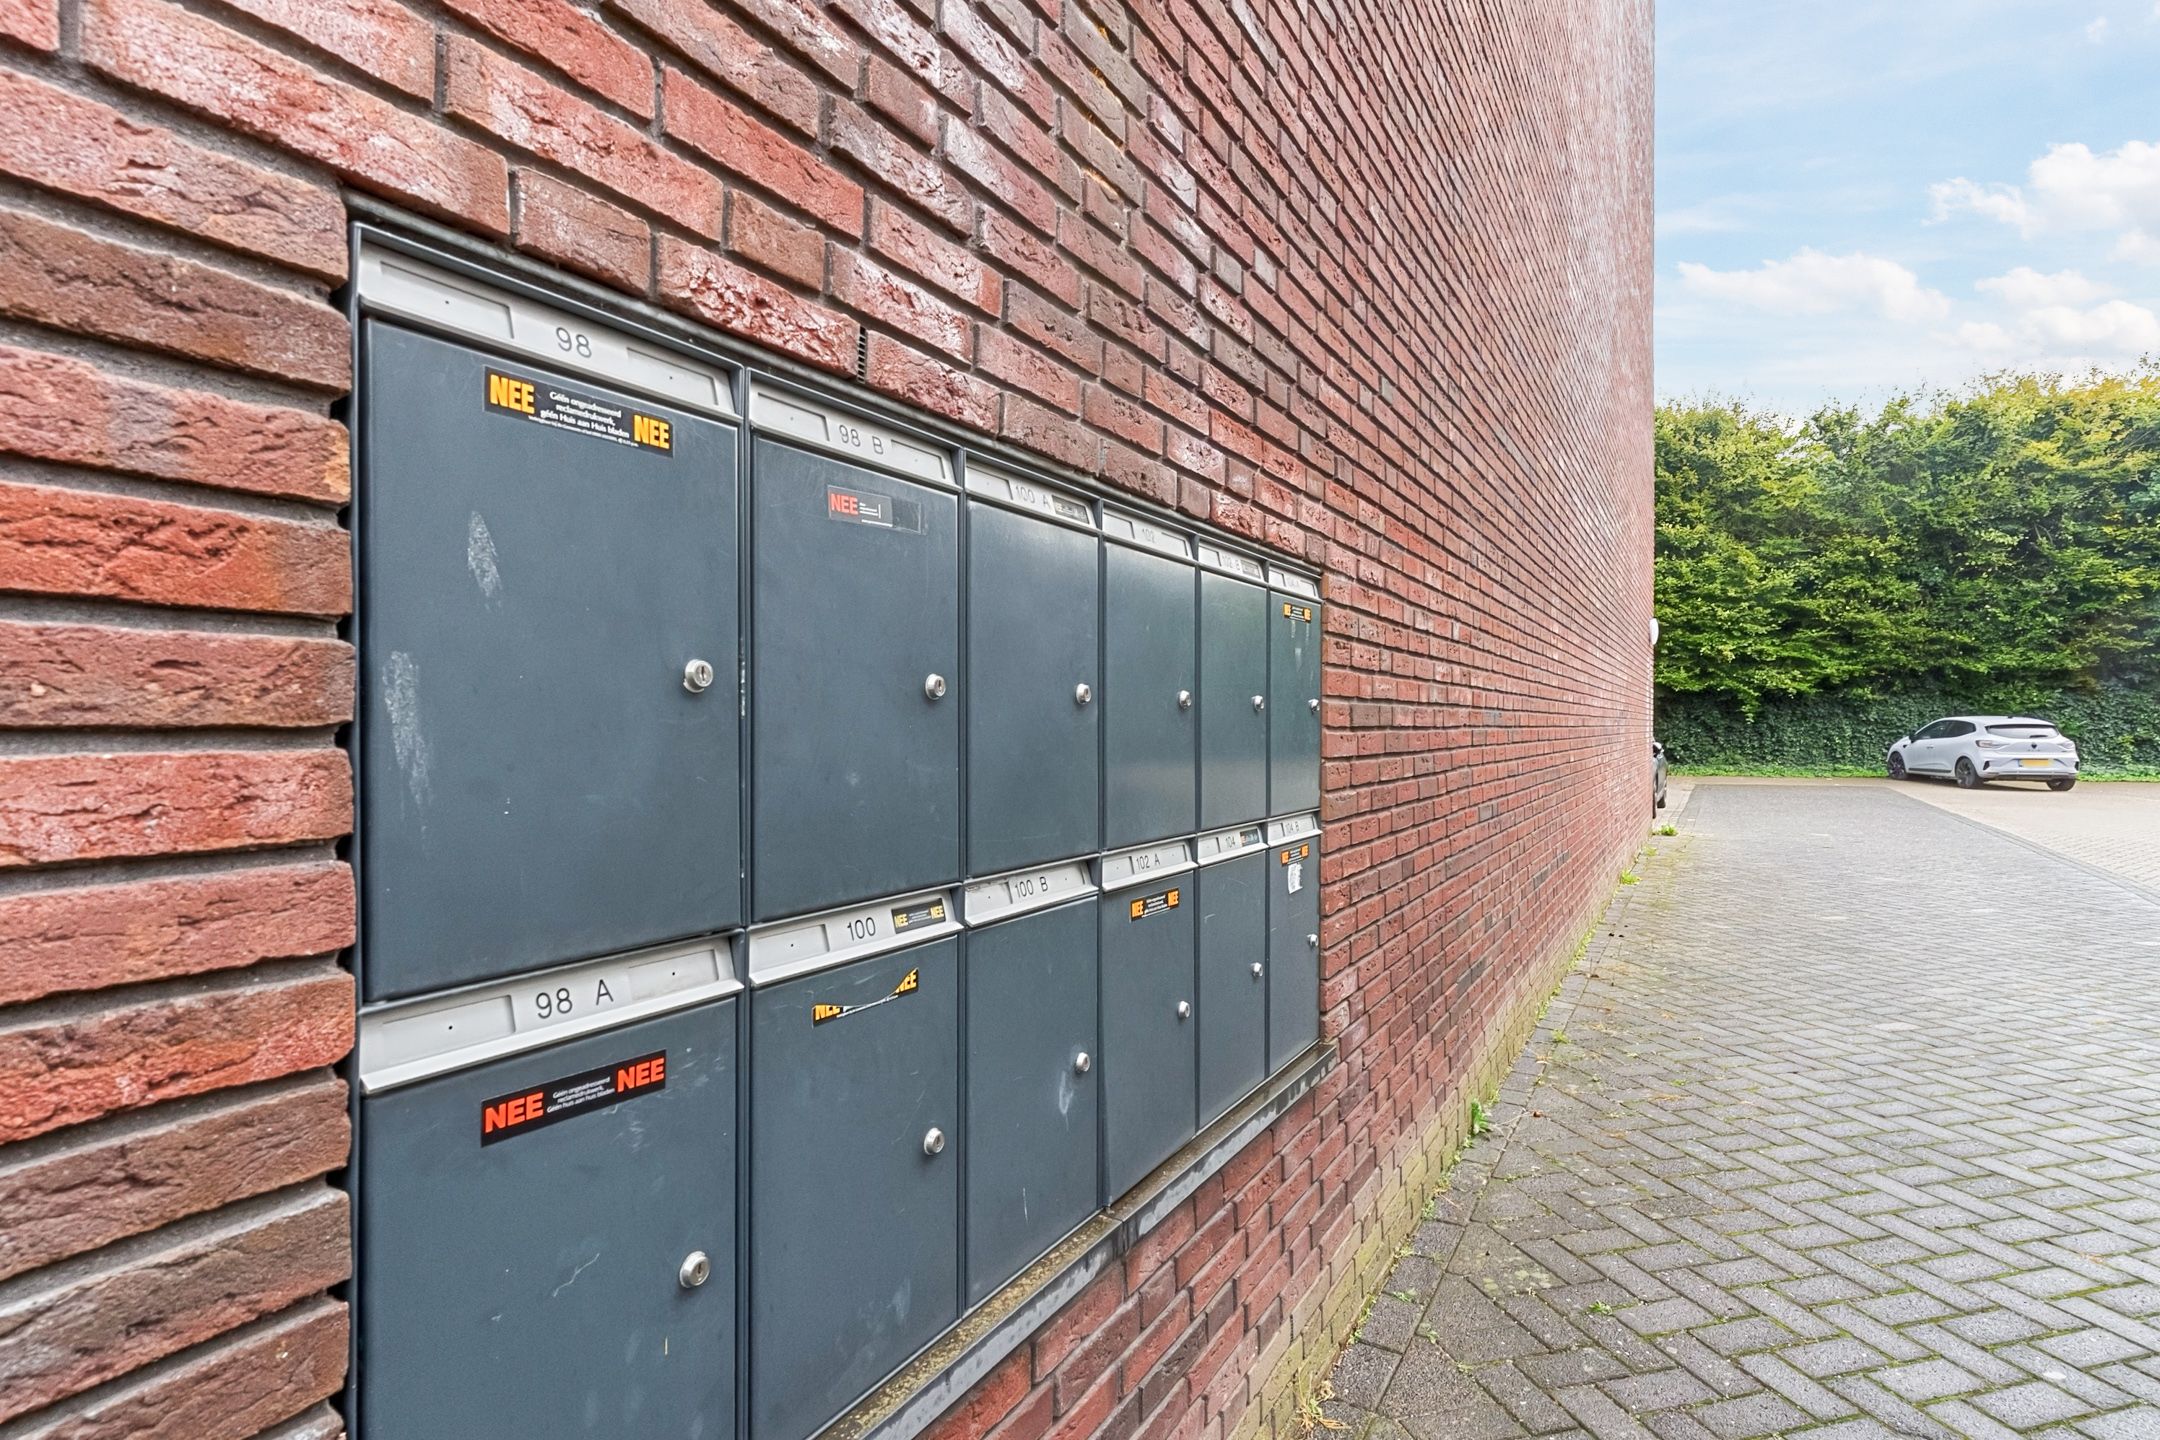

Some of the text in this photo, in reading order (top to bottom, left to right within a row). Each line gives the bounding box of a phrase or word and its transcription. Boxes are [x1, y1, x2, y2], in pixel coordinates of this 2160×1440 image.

[556, 327, 592, 358] 98
[489, 374, 535, 414] NEE
[559, 413, 576, 424] Huis
[591, 421, 606, 432] Huis
[633, 414, 670, 449] NEE
[839, 424, 884, 455] 98 B
[830, 493, 859, 515] NEE
[1016, 485, 1051, 508] 100 A
[1136, 853, 1160, 870] 102 A
[1015, 876, 1048, 898] 100 B
[894, 913, 909, 928] NEE
[930, 905, 945, 920] NEE
[847, 917, 876, 941] 100
[535, 979, 614, 1019] 98 A
[617, 1057, 665, 1093] NEE
[485, 1092, 544, 1133] NEE
